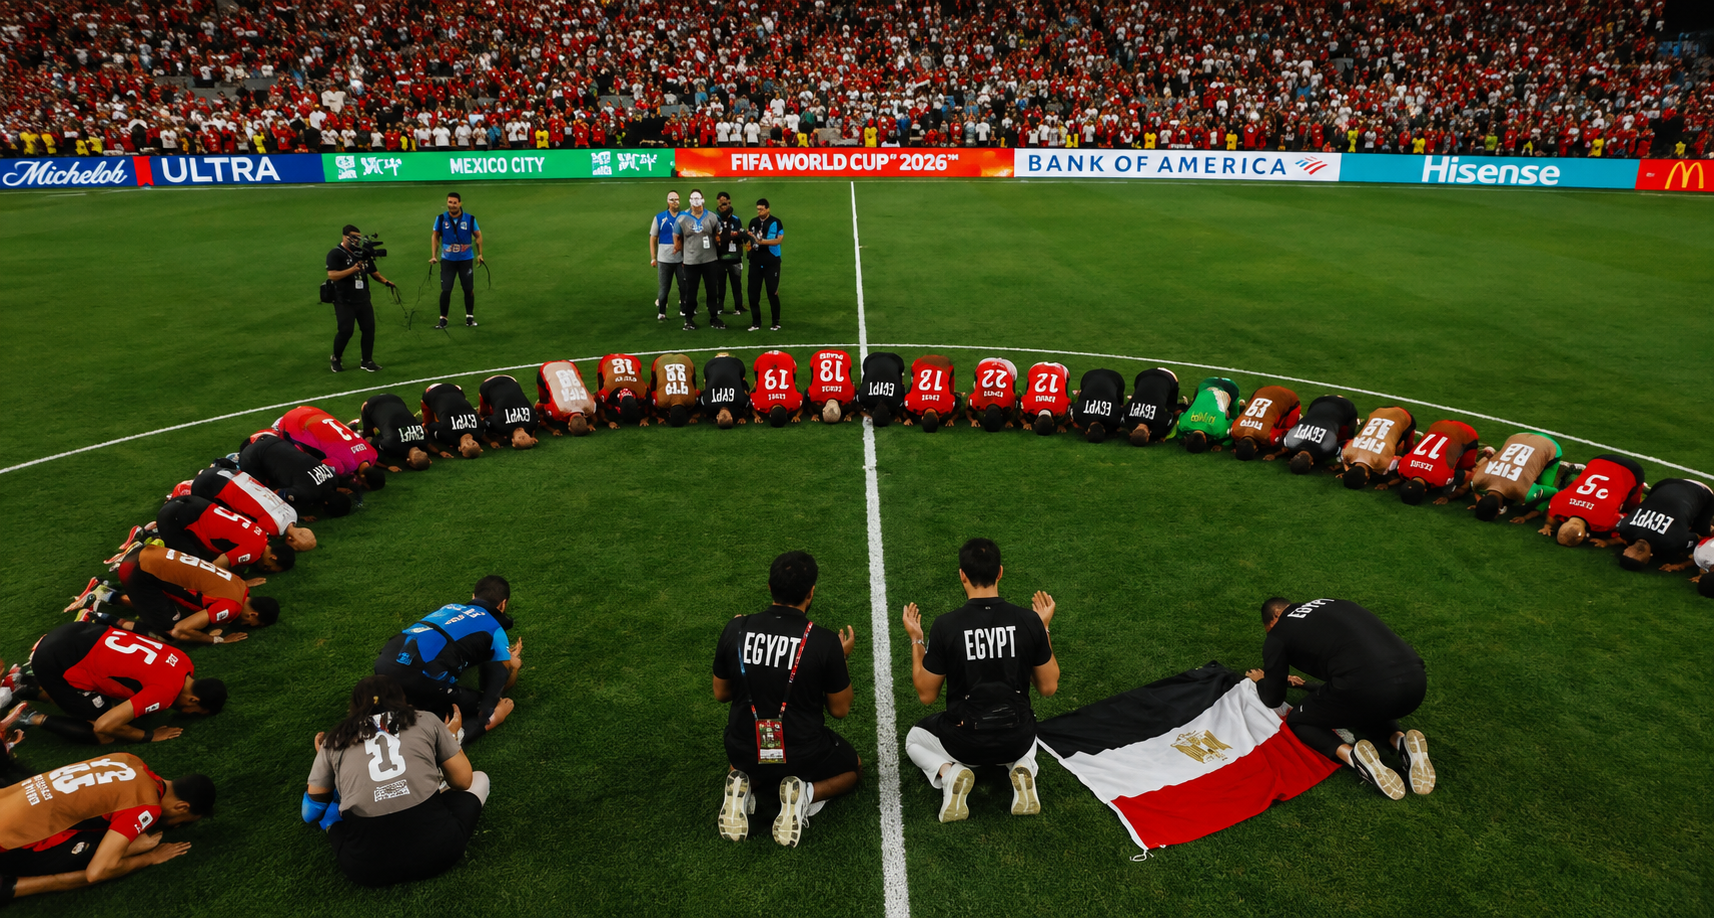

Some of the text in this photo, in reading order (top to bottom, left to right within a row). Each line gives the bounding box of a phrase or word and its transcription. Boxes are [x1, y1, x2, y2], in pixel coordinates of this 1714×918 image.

[2, 156, 281, 187] Michelob ULTRA
[449, 156, 545, 174] MEXICO CITY
[731, 153, 774, 171] FIFA
[775, 153, 848, 171] WORLD
[1028, 154, 1287, 175] BANK OF AMERICA
[1421, 155, 1561, 186] Hisense
[819, 359, 845, 382] 18
[981, 368, 1008, 389] 22
[1034, 372, 1059, 393] 12
[1083, 399, 1112, 417] EGYPT
[1290, 423, 1327, 444] EGYPT
[1351, 435, 1387, 455] FIFA
[1413, 431, 1448, 460] 17
[1484, 459, 1524, 482] FIFA
[1629, 508, 1675, 535] EGYPT
[743, 631, 802, 670] EGYPT
[963, 625, 1016, 661] EGYPT
